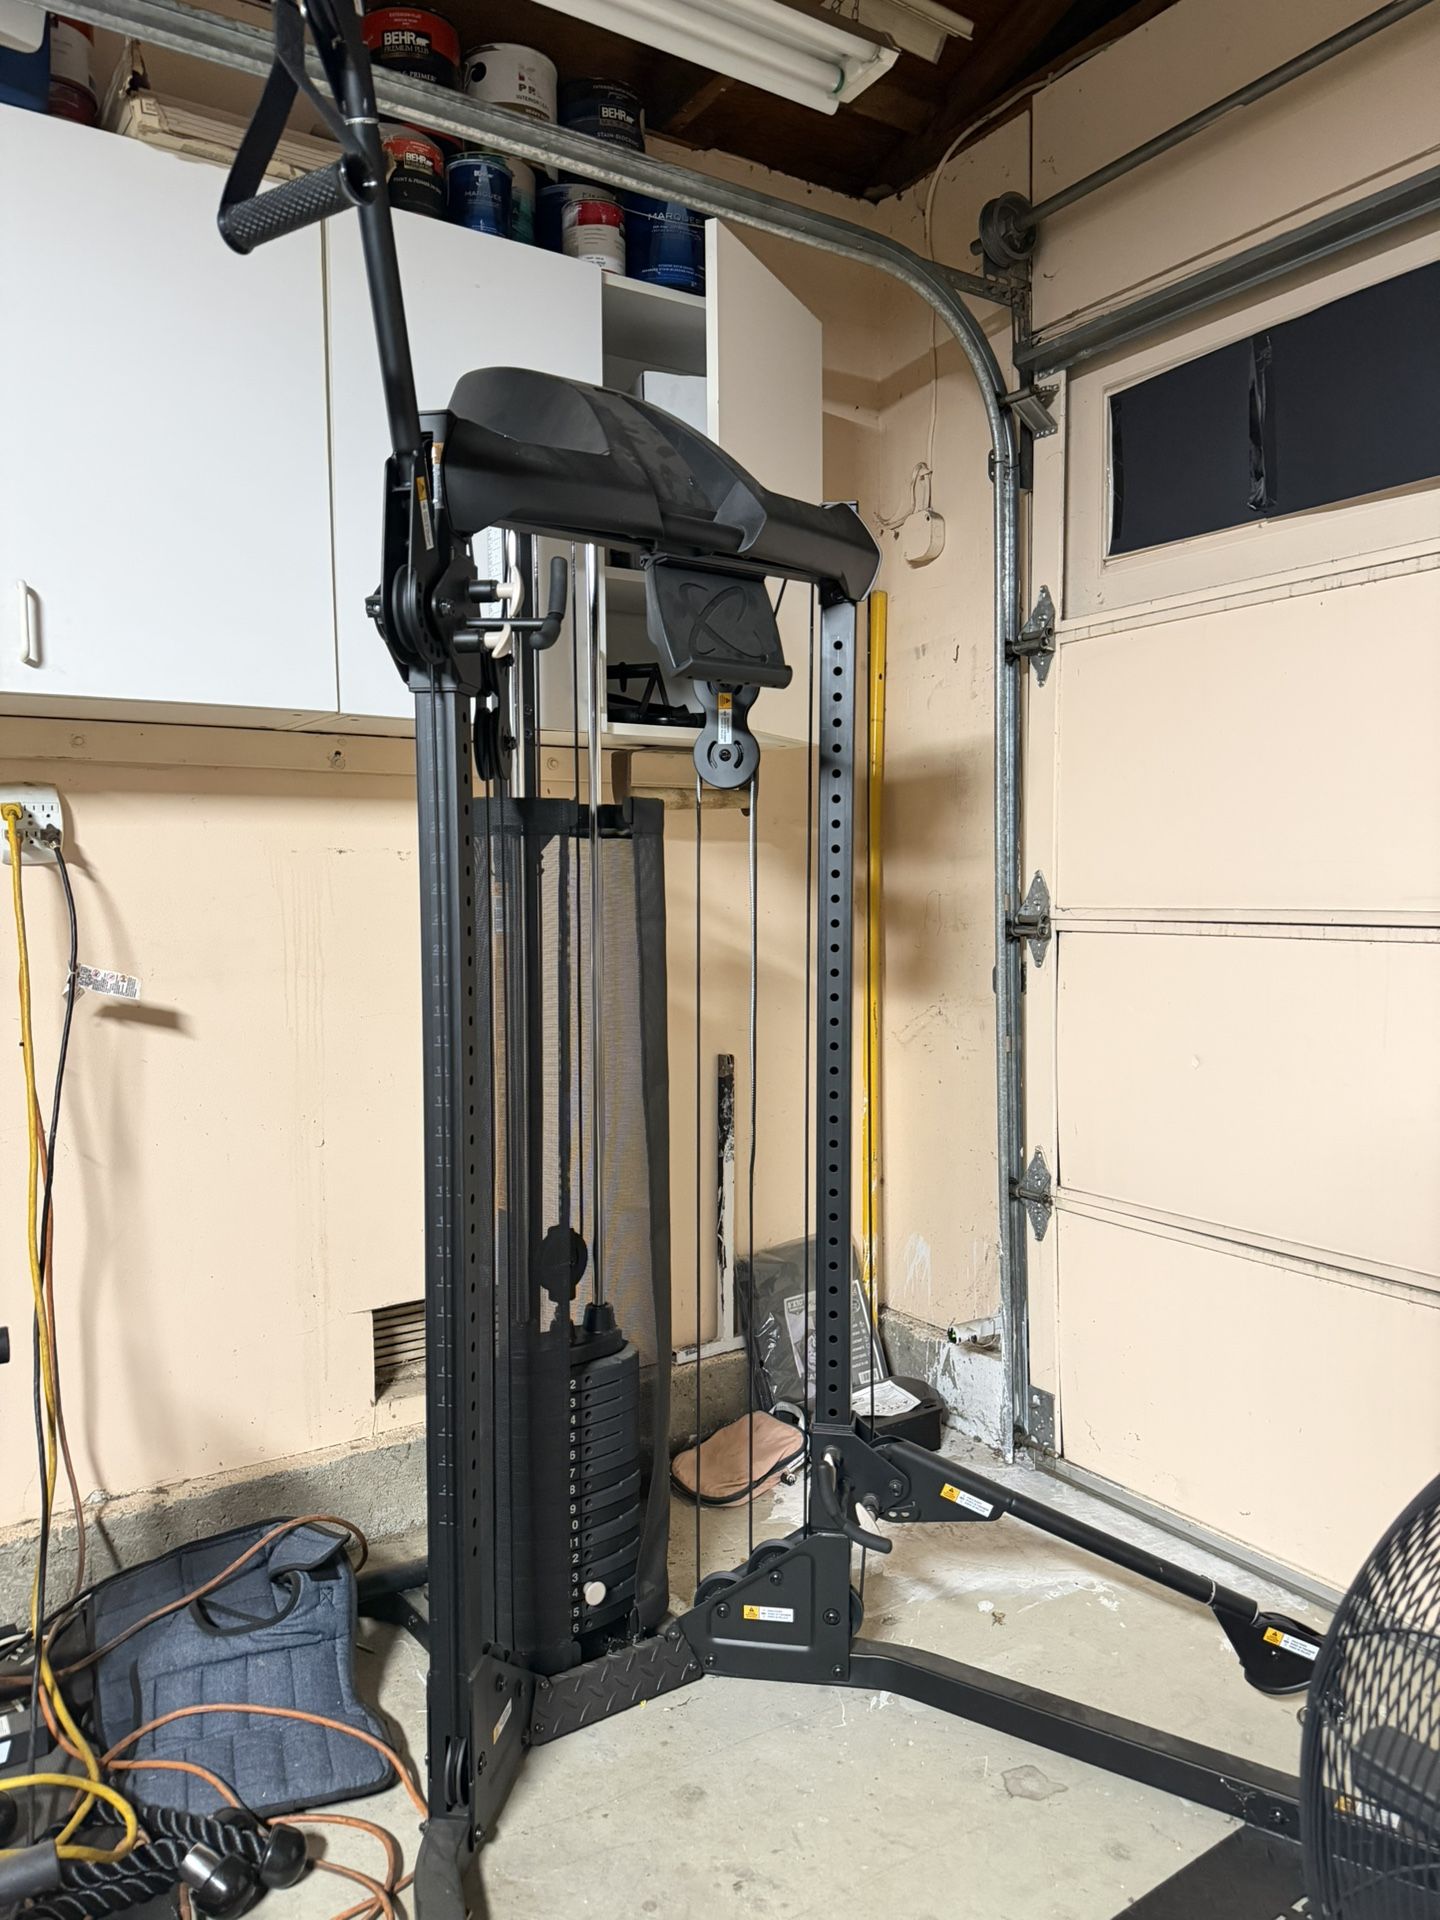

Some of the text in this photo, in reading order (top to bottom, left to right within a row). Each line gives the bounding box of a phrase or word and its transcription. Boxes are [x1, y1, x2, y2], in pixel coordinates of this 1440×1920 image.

[384, 31, 416, 46] BEHR
[601, 106, 627, 121] BEHR
[405, 152, 427, 164] BEHR
[570, 1379, 577, 1390] 2
[570, 1397, 577, 1408] 3
[570, 1414, 577, 1425] 4
[569, 1431, 576, 1443] 5
[569, 1450, 576, 1460] 6
[569, 1467, 576, 1479] 7
[569, 1484, 576, 1495] 8
[569, 1503, 577, 1514] 9
